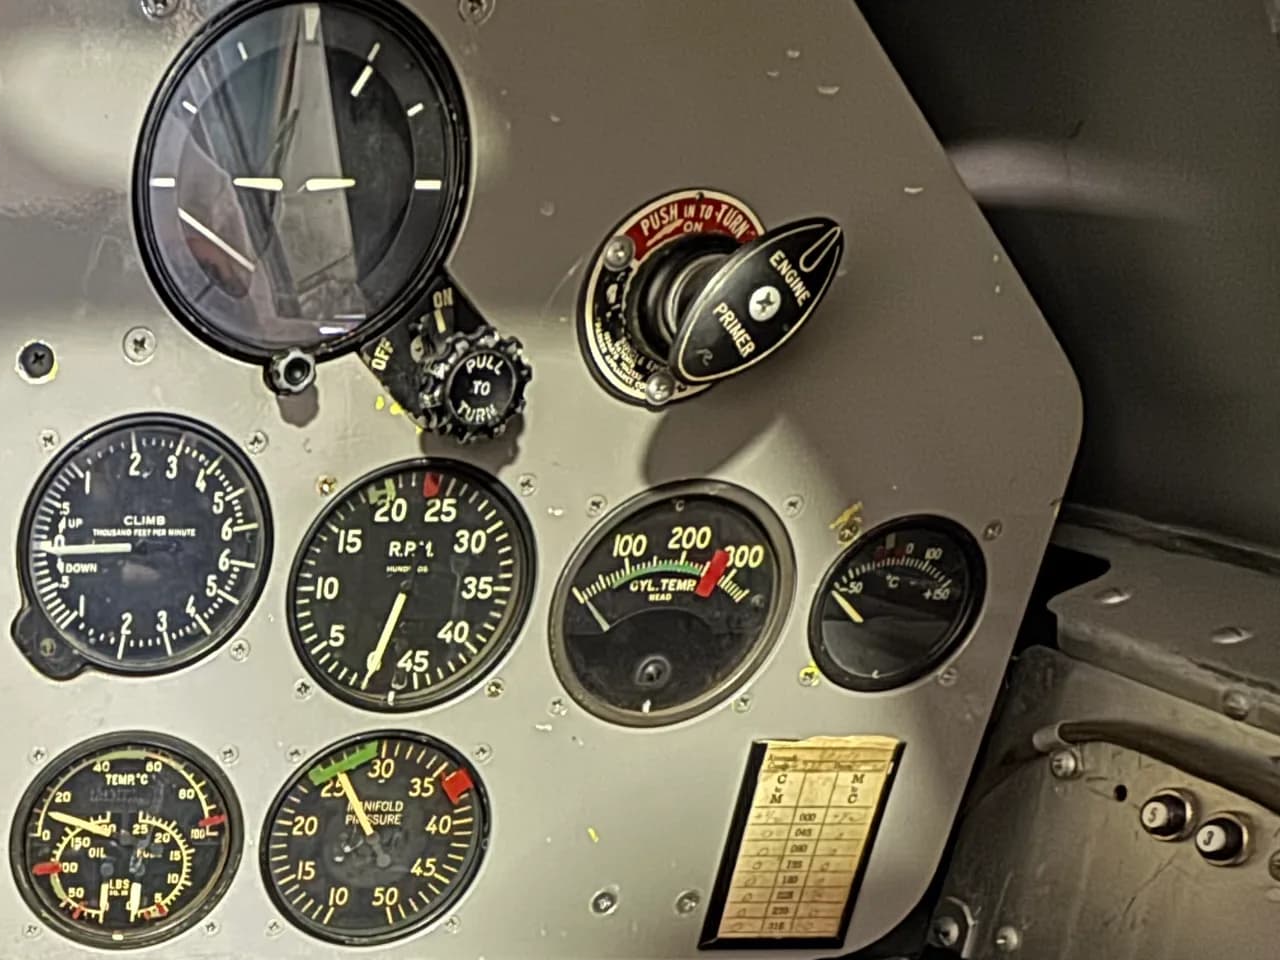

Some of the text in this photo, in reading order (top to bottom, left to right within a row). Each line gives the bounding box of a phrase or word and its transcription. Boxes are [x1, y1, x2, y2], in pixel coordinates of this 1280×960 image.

[639, 203, 751, 239] PUSH IN TO TURN
[683, 221, 704, 233] ON
[769, 249, 812, 308] ENGINE
[432, 288, 454, 309] ON
[712, 301, 756, 359] PRIMER
[466, 353, 504, 376] PULL
[472, 380, 491, 396] TO
[457, 400, 498, 423] TURN
[129, 452, 141, 476] 2
[424, 498, 458, 522] 25
[69, 518, 84, 528] UP
[123, 515, 166, 526] CLIMB
[93, 529, 132, 537] THOUSAND
[168, 528, 196, 537] MINUTE
[338, 529, 363, 553] 15
[668, 526, 713, 549] 200
[906, 543, 915, 555] 0
[65, 563, 98, 573] DOWN
[92, 761, 111, 773] 40
[55, 792, 72, 804] 20
[425, 814, 452, 834] 40
[1147, 807, 1159, 823] 5
[292, 815, 318, 836] 20
[88, 848, 107, 858] OIL
[108, 879, 130, 891] LBS
